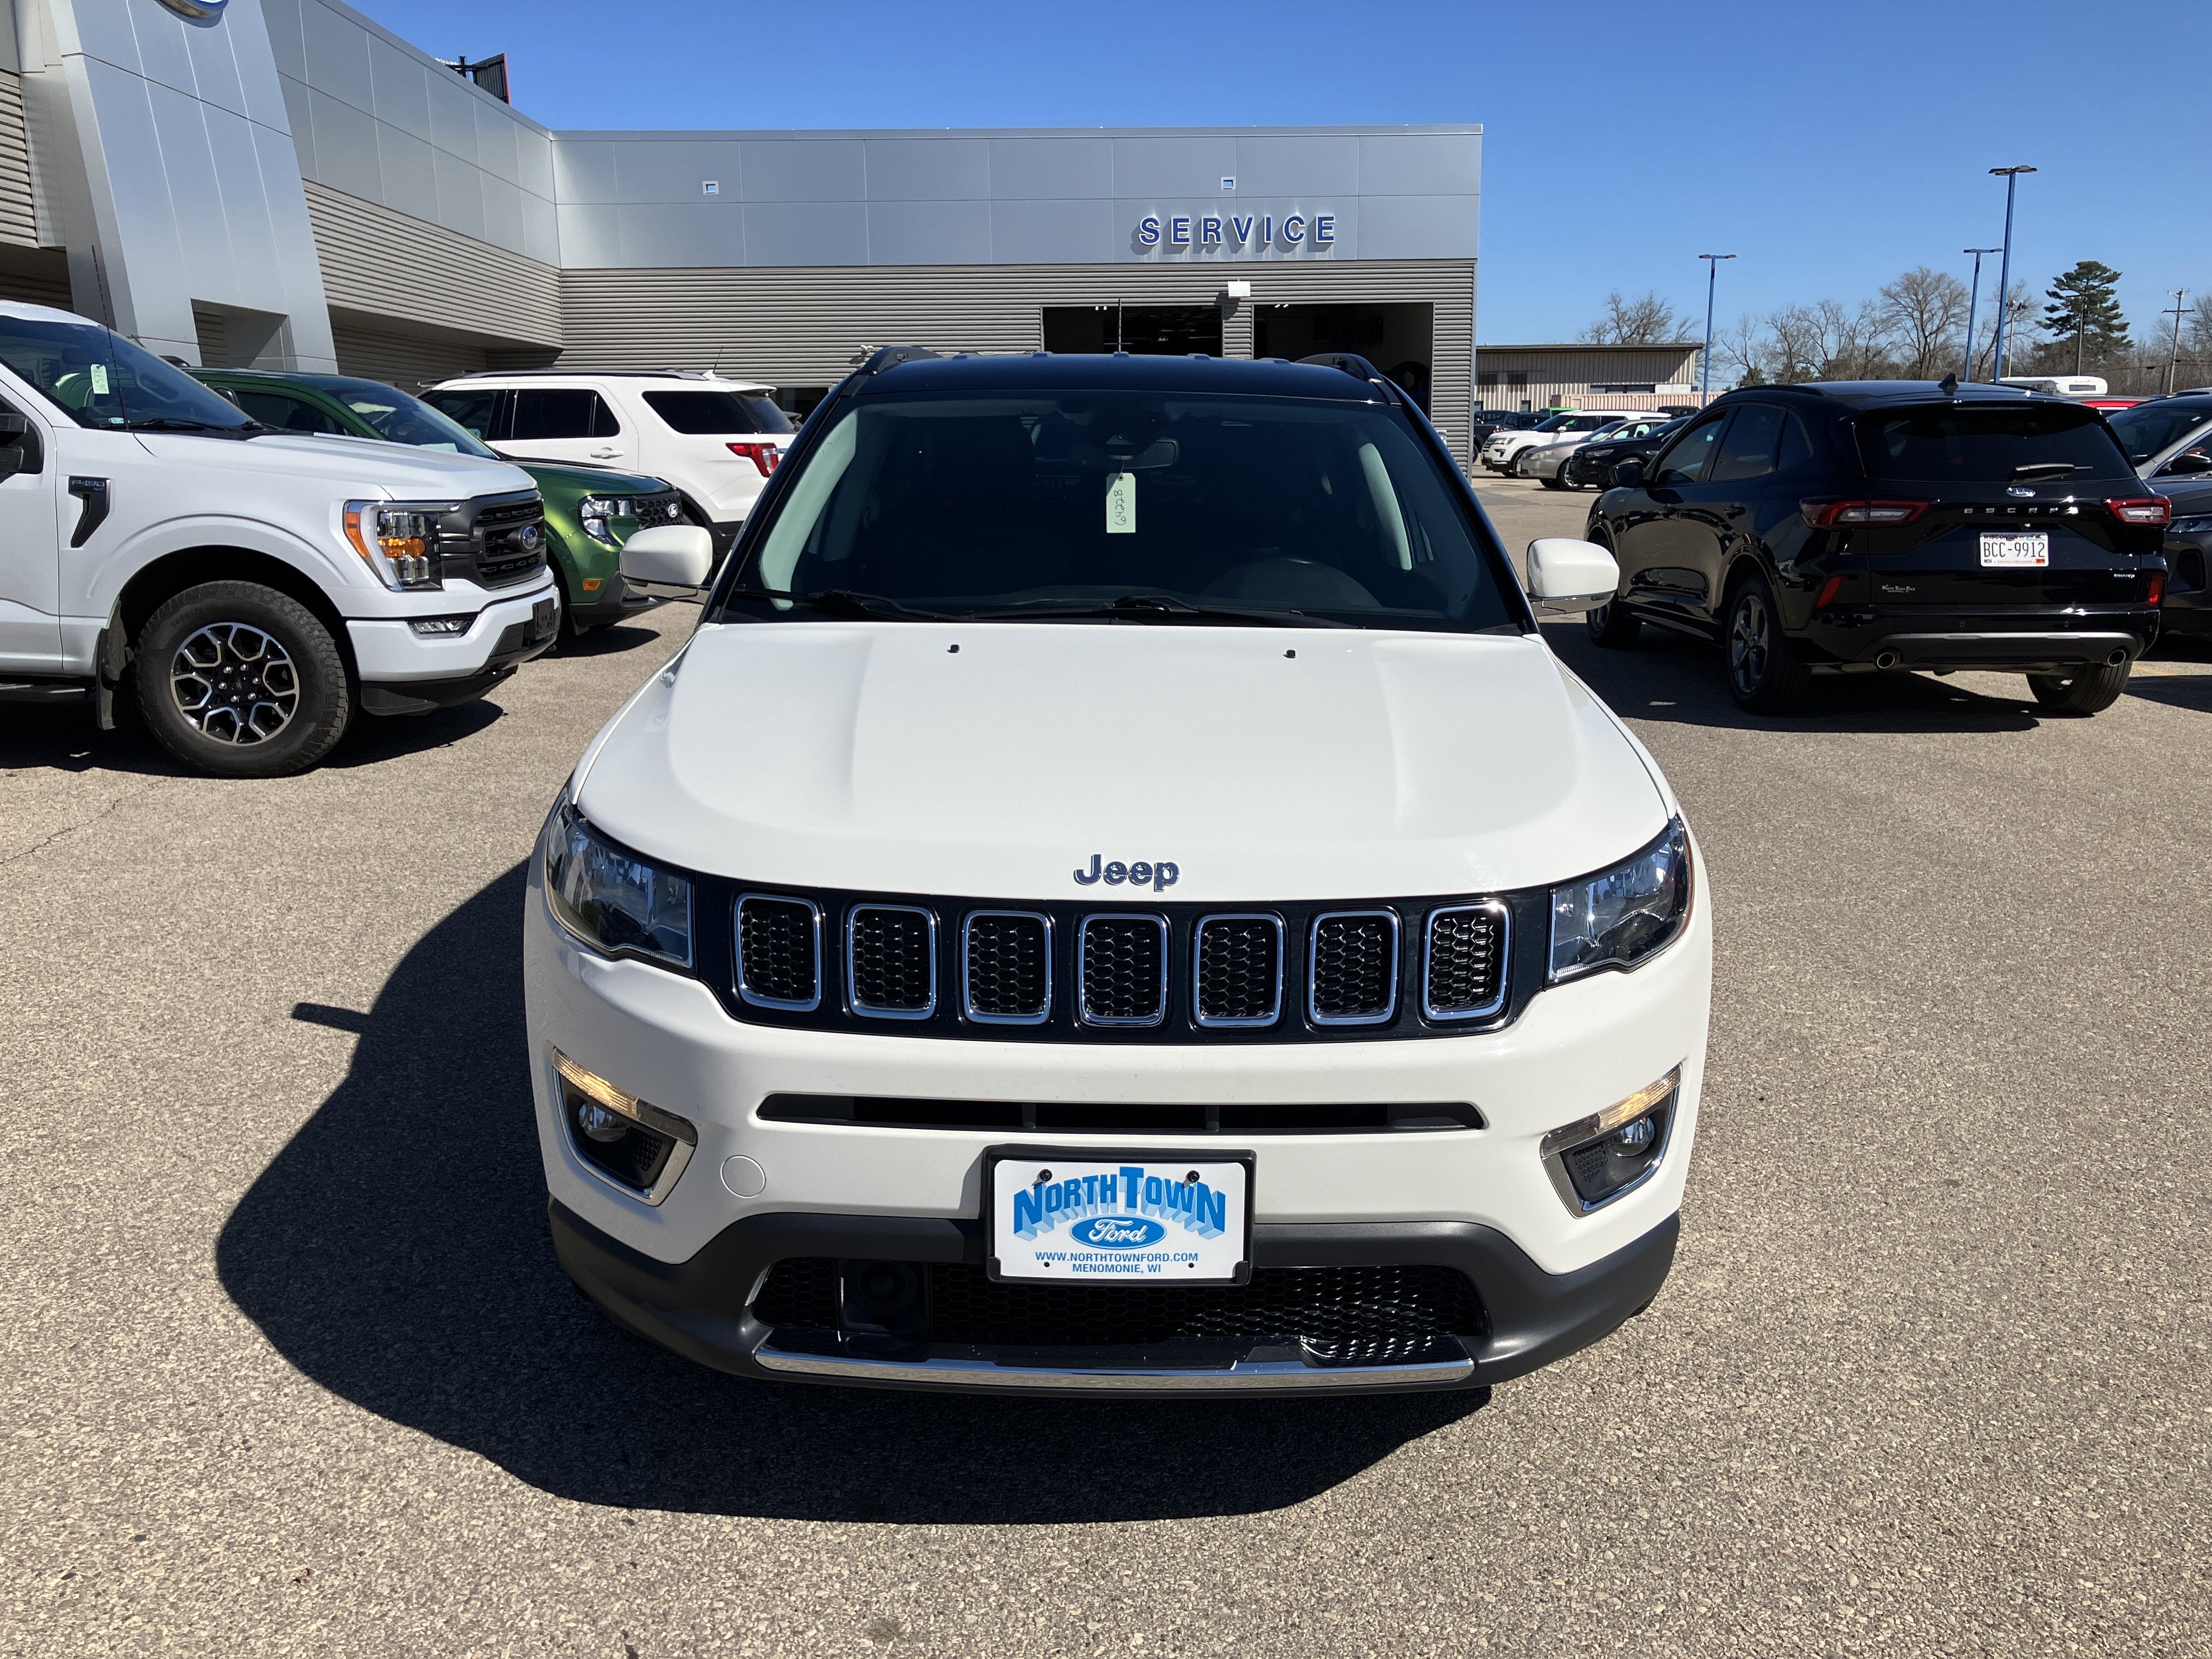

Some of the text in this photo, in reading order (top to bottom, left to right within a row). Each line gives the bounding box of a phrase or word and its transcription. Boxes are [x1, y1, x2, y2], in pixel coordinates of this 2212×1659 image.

[1139, 216, 1335, 245] SERVICE
[1114, 489, 1126, 525] 6422B
[1984, 542, 2045, 557] BCC-9912
[1073, 854, 1180, 892] Jeep
[1013, 1166, 1227, 1238] NORTH TOWN
[1088, 1218, 1148, 1243] Ford
[1035, 1251, 1198, 1262] WWW.NORTHTOWNFORD.COM
[1073, 1263, 1161, 1273] MENOMONIE, WI
